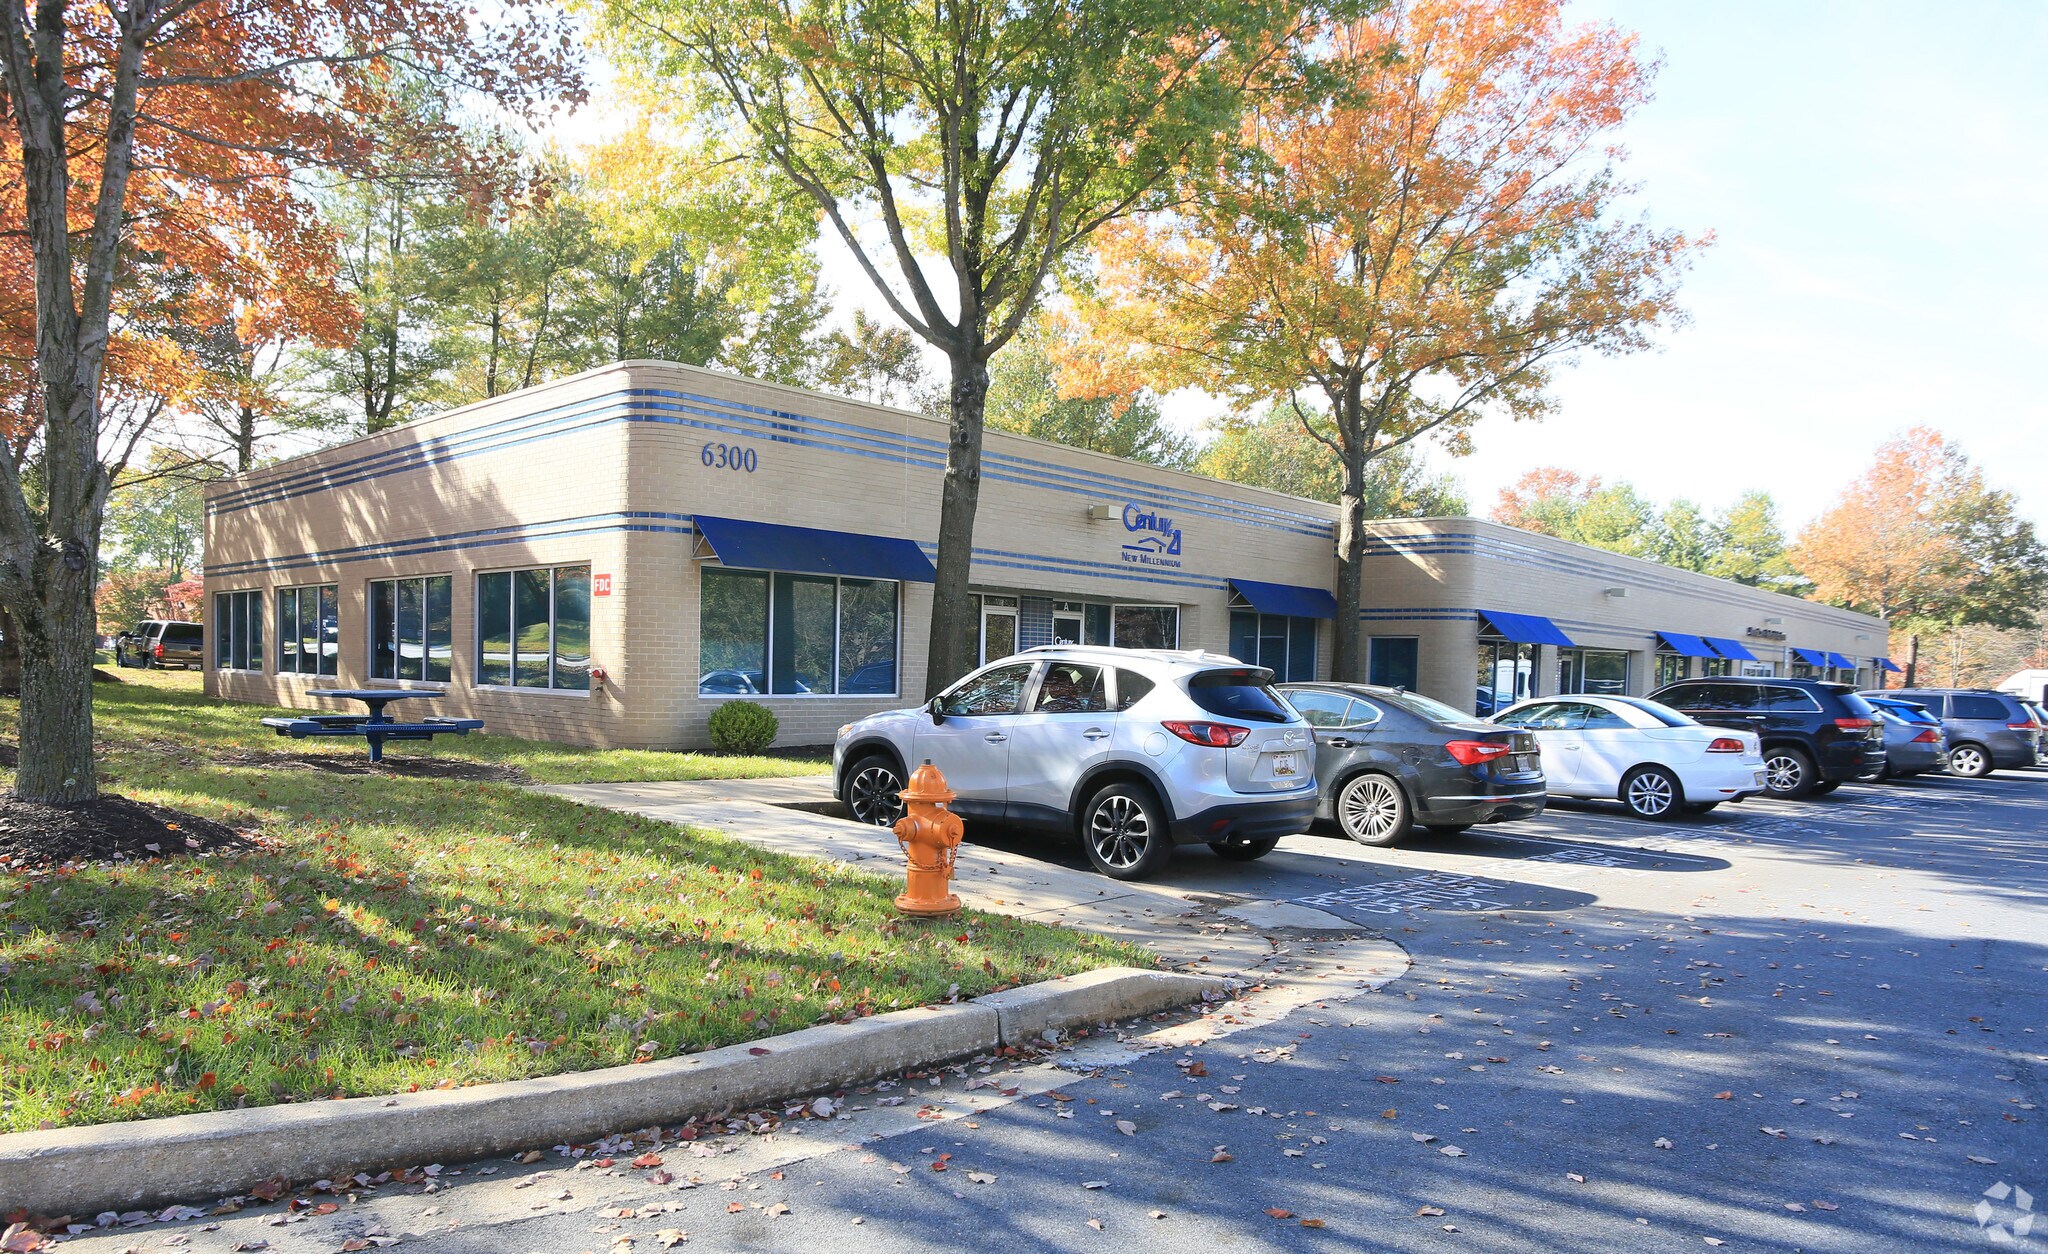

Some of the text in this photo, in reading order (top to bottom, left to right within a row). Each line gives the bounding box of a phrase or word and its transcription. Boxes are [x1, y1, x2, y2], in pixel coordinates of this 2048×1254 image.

[701, 442, 758, 473] 6300
[1123, 502, 1182, 555] Century 21
[1121, 551, 1181, 568] NEW MILLENNIUM
[594, 578, 610, 592] FDC
[1063, 602, 1069, 611] A
[1294, 873, 1474, 907] RESERVED
[1353, 880, 1506, 914] CENTURY
[1452, 898, 1513, 911] 21
